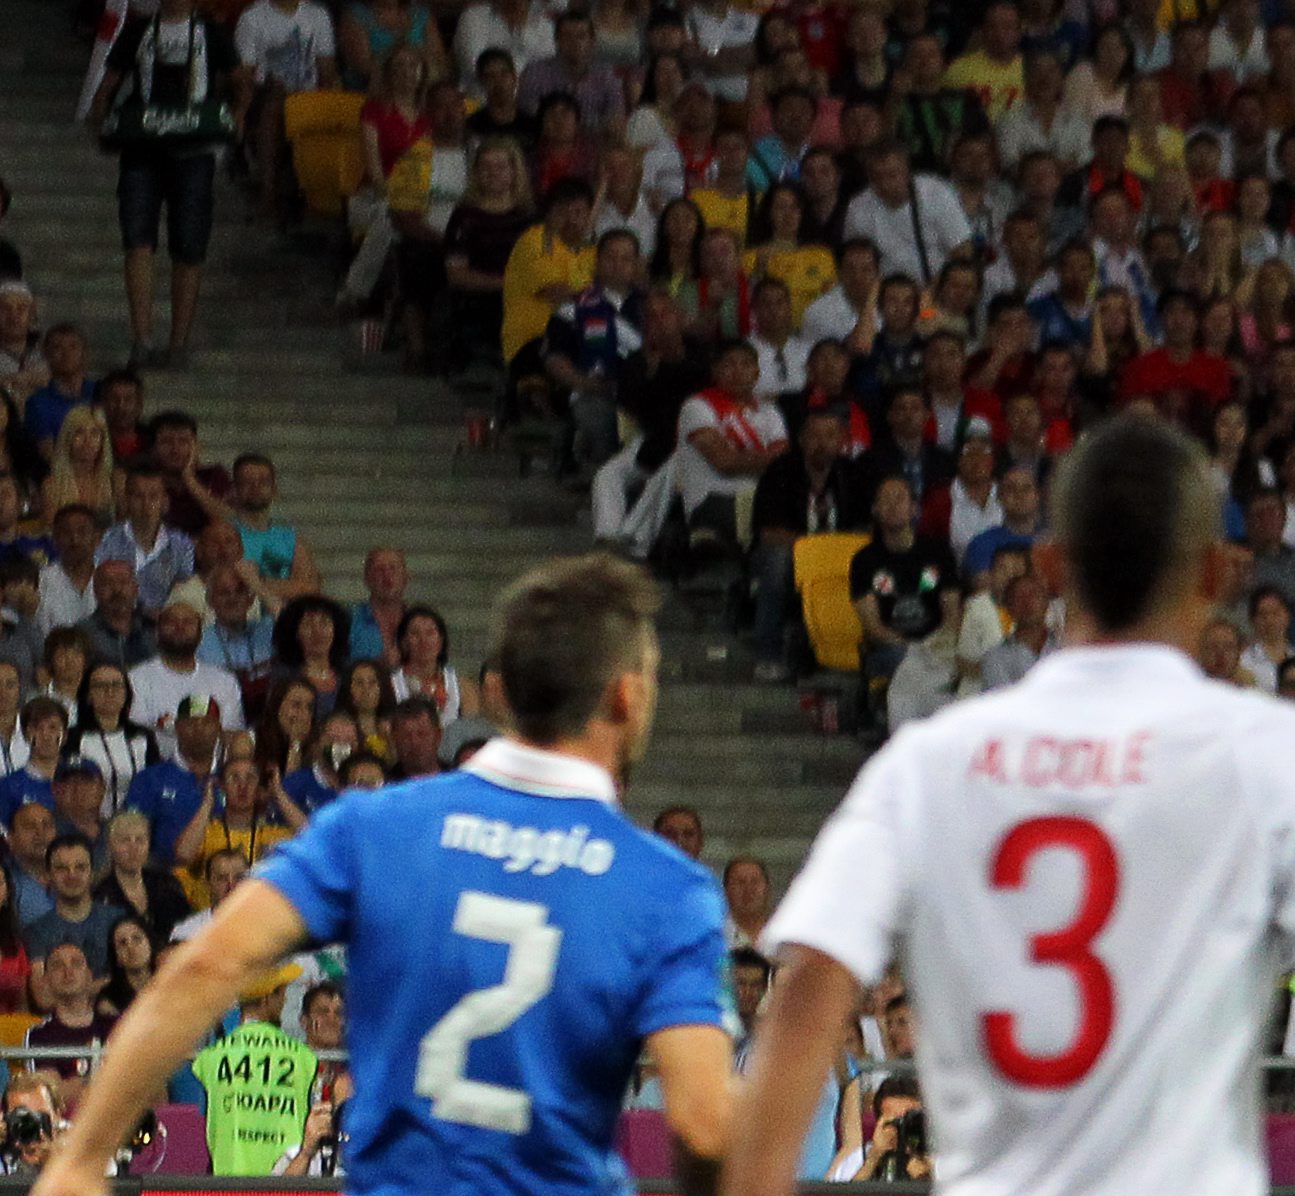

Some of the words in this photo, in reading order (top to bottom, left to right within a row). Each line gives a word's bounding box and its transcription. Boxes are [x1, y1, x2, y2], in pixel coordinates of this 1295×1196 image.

[440, 813, 616, 877] maggio
[414, 889, 564, 1136] 2
[979, 813, 1121, 1091] 3
[217, 1054, 296, 1087] 4412
